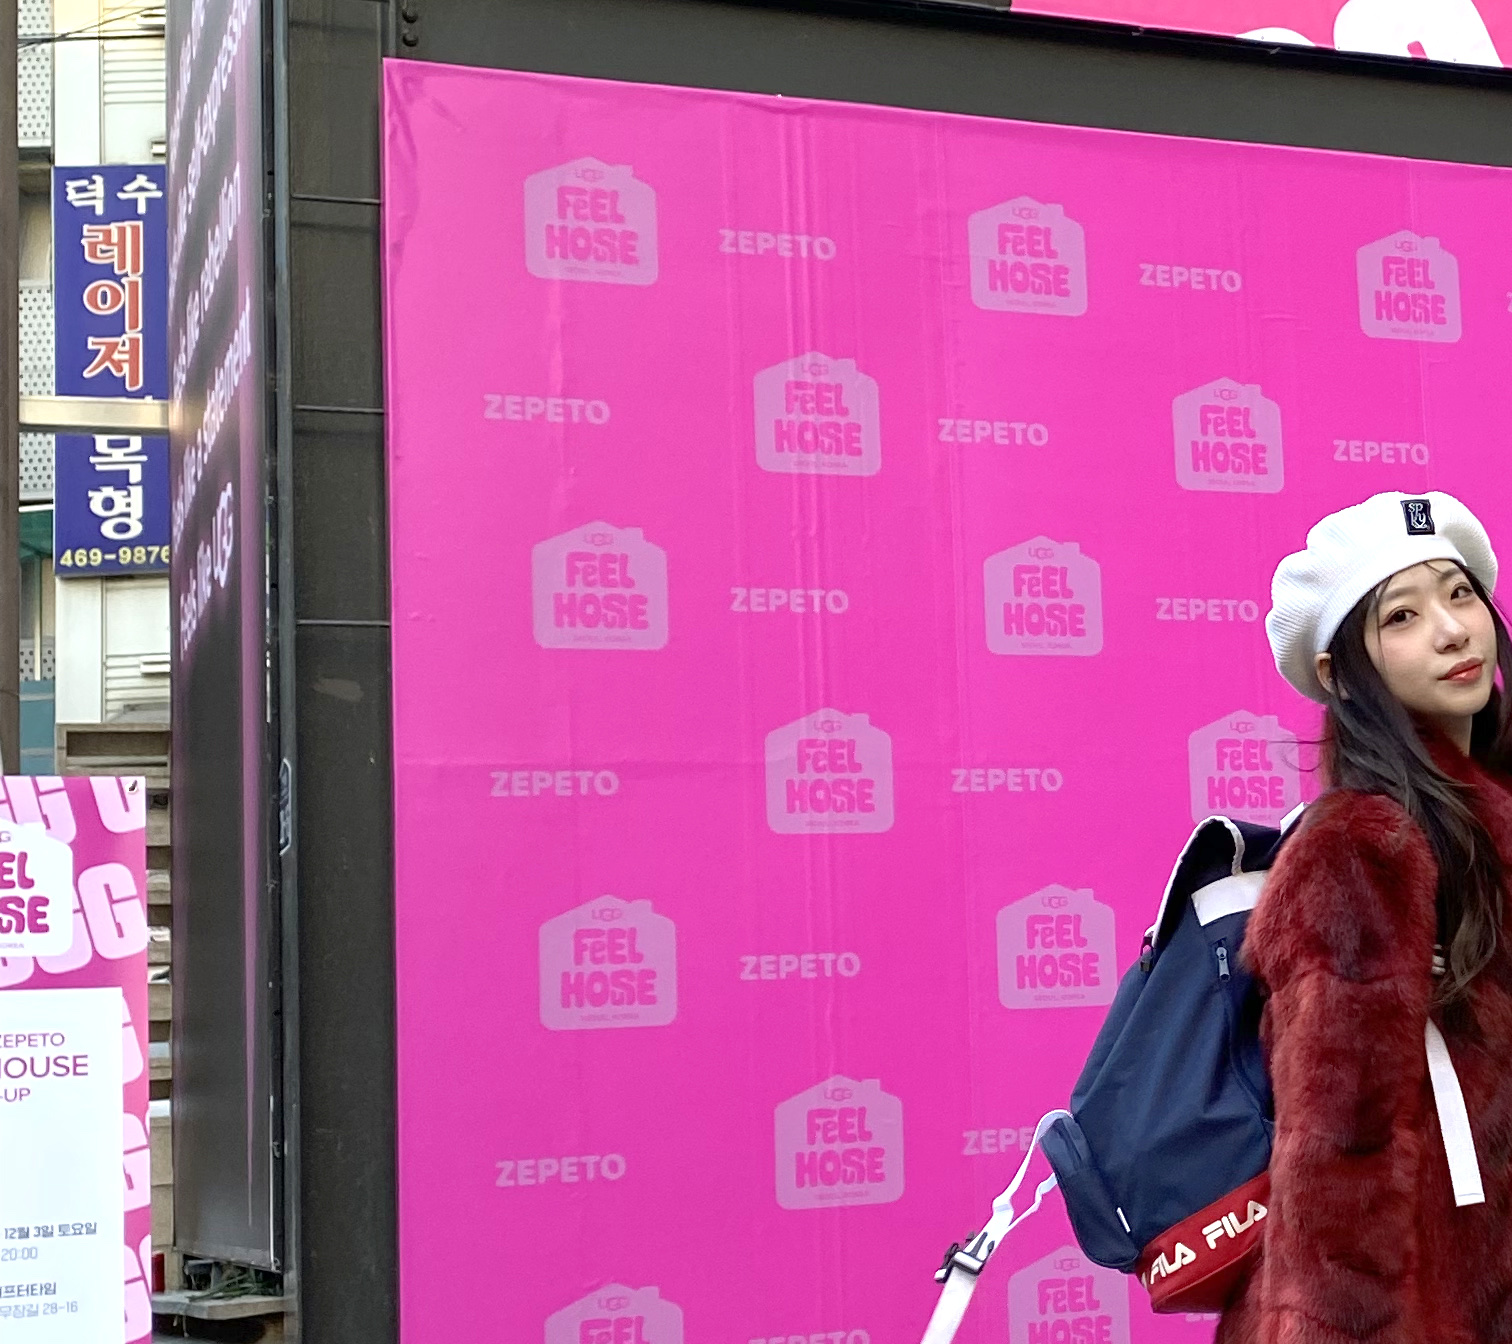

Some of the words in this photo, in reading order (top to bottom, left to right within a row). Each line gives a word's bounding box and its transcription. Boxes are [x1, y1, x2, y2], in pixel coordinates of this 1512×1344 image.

[719, 229, 836, 260] ZEPETO
[1139, 263, 1242, 292] ZEPETO
[485, 394, 610, 424] ZEPETO
[939, 418, 1049, 446] ZEPETO
[1332, 439, 1431, 465] ZEPETO
[731, 587, 849, 614] ZEPETO
[1155, 598, 1257, 623] ZEPETO
[492, 770, 619, 796] ZEPETO
[951, 768, 1063, 793] ZEPETO
[741, 952, 861, 980] ZEPETO
[0, 1055, 89, 1079] OUSE
[963, 1124, 1036, 1156] ZEPE
[497, 1153, 626, 1187] ZEPETO
[1150, 1242, 1197, 1285] FILA
[1202, 1200, 1268, 1250] FILA
